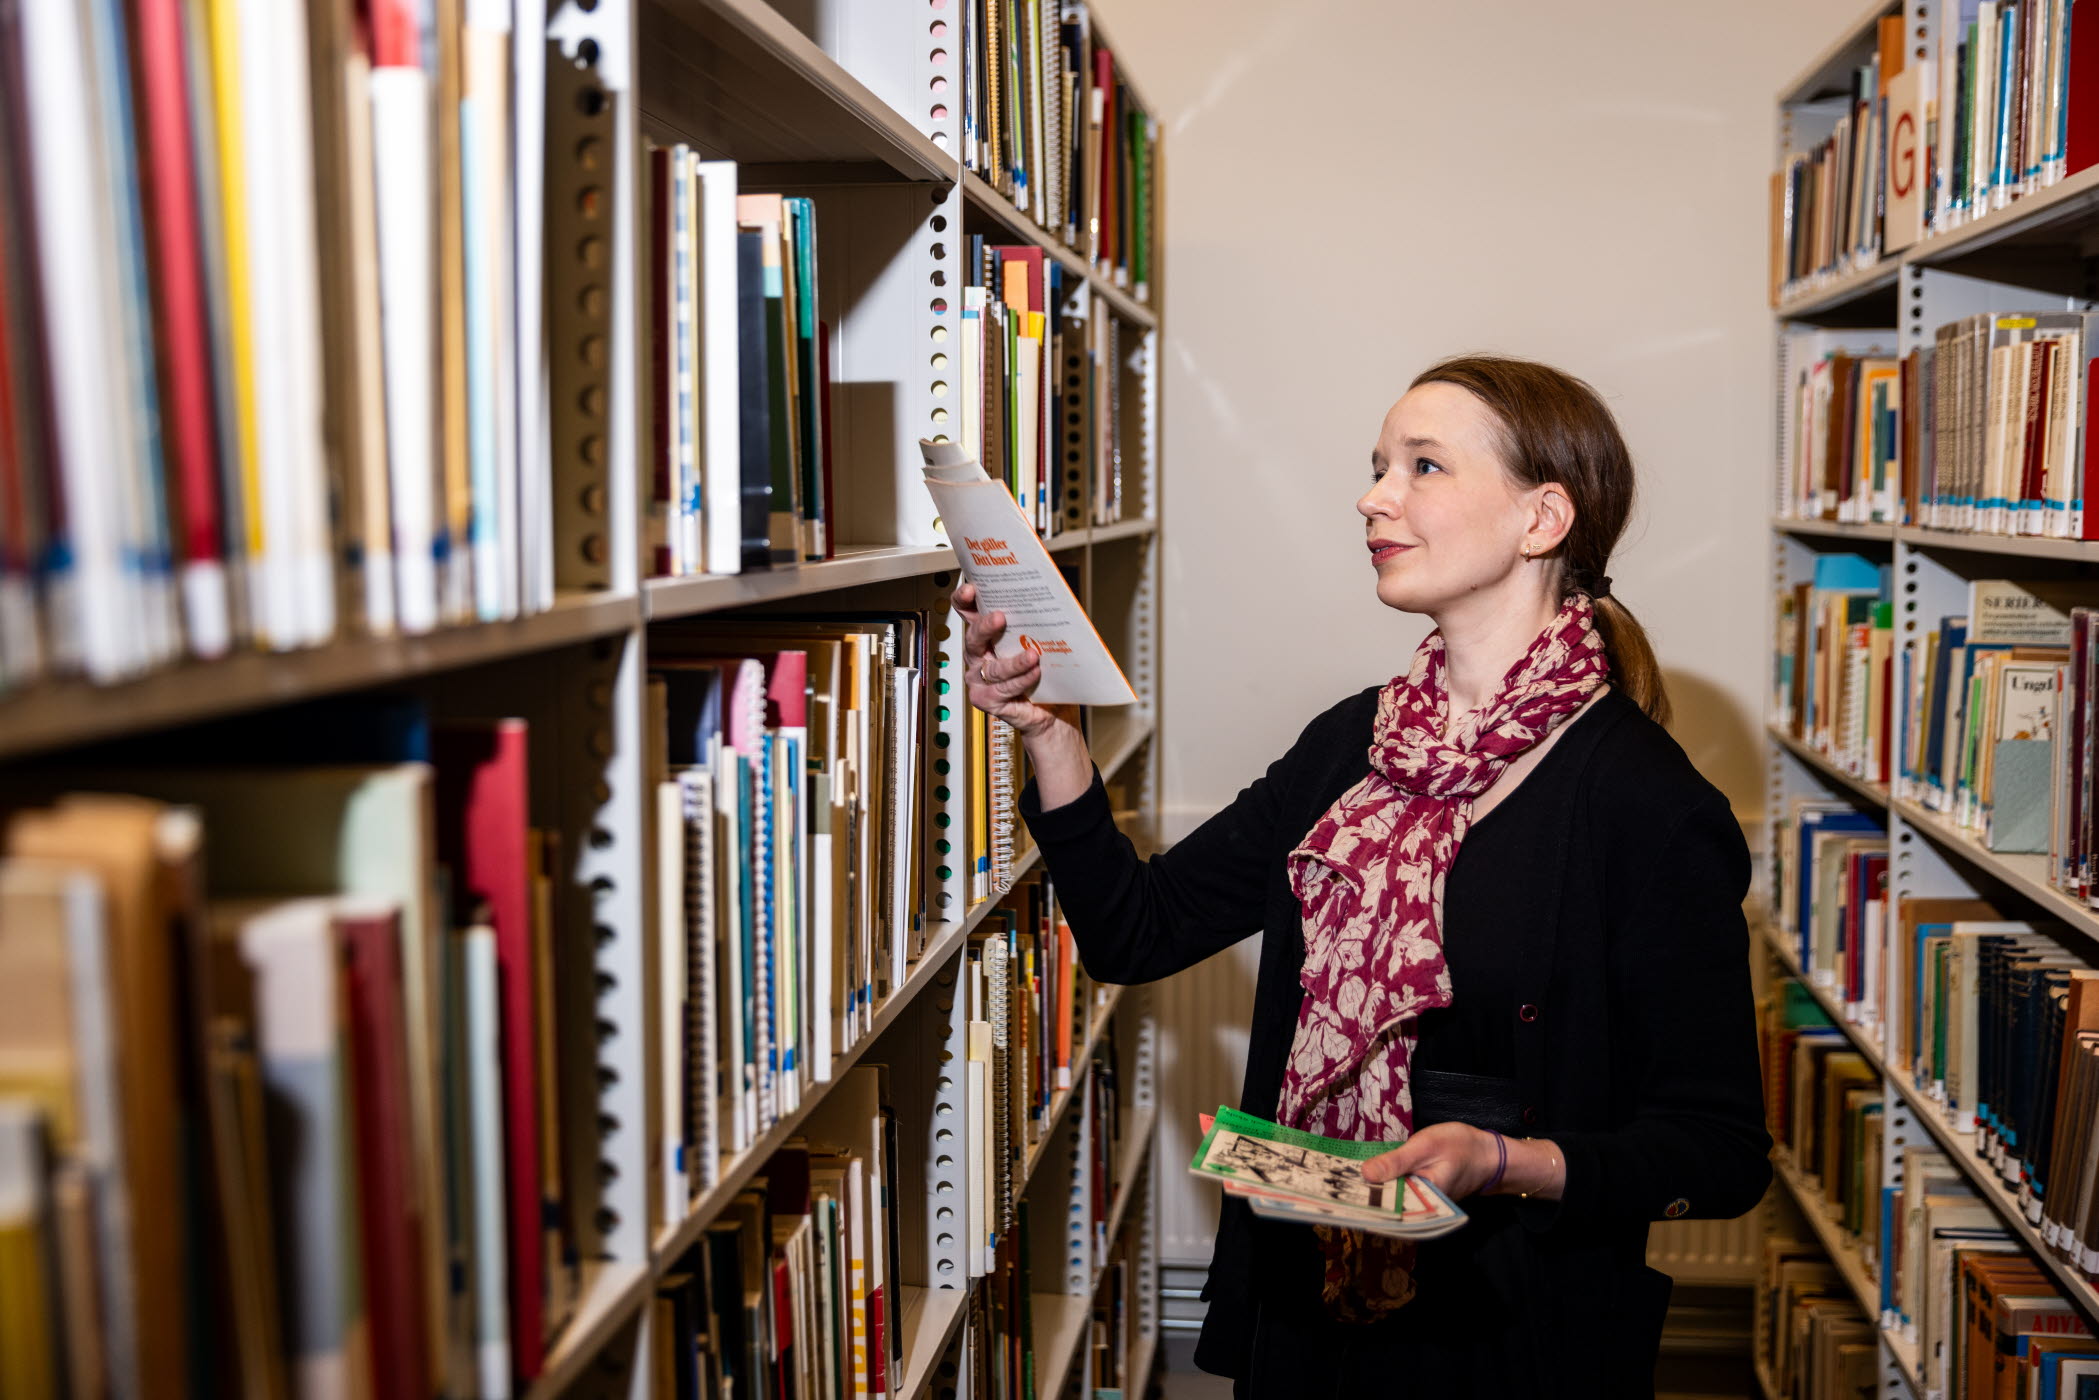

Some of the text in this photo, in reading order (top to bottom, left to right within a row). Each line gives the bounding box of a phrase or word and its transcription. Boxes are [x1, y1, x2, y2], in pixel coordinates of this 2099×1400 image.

[1890, 112, 1916, 199] G
[964, 536, 1008, 553] Det gäller
[970, 551, 1019, 566] Ditt barn!
